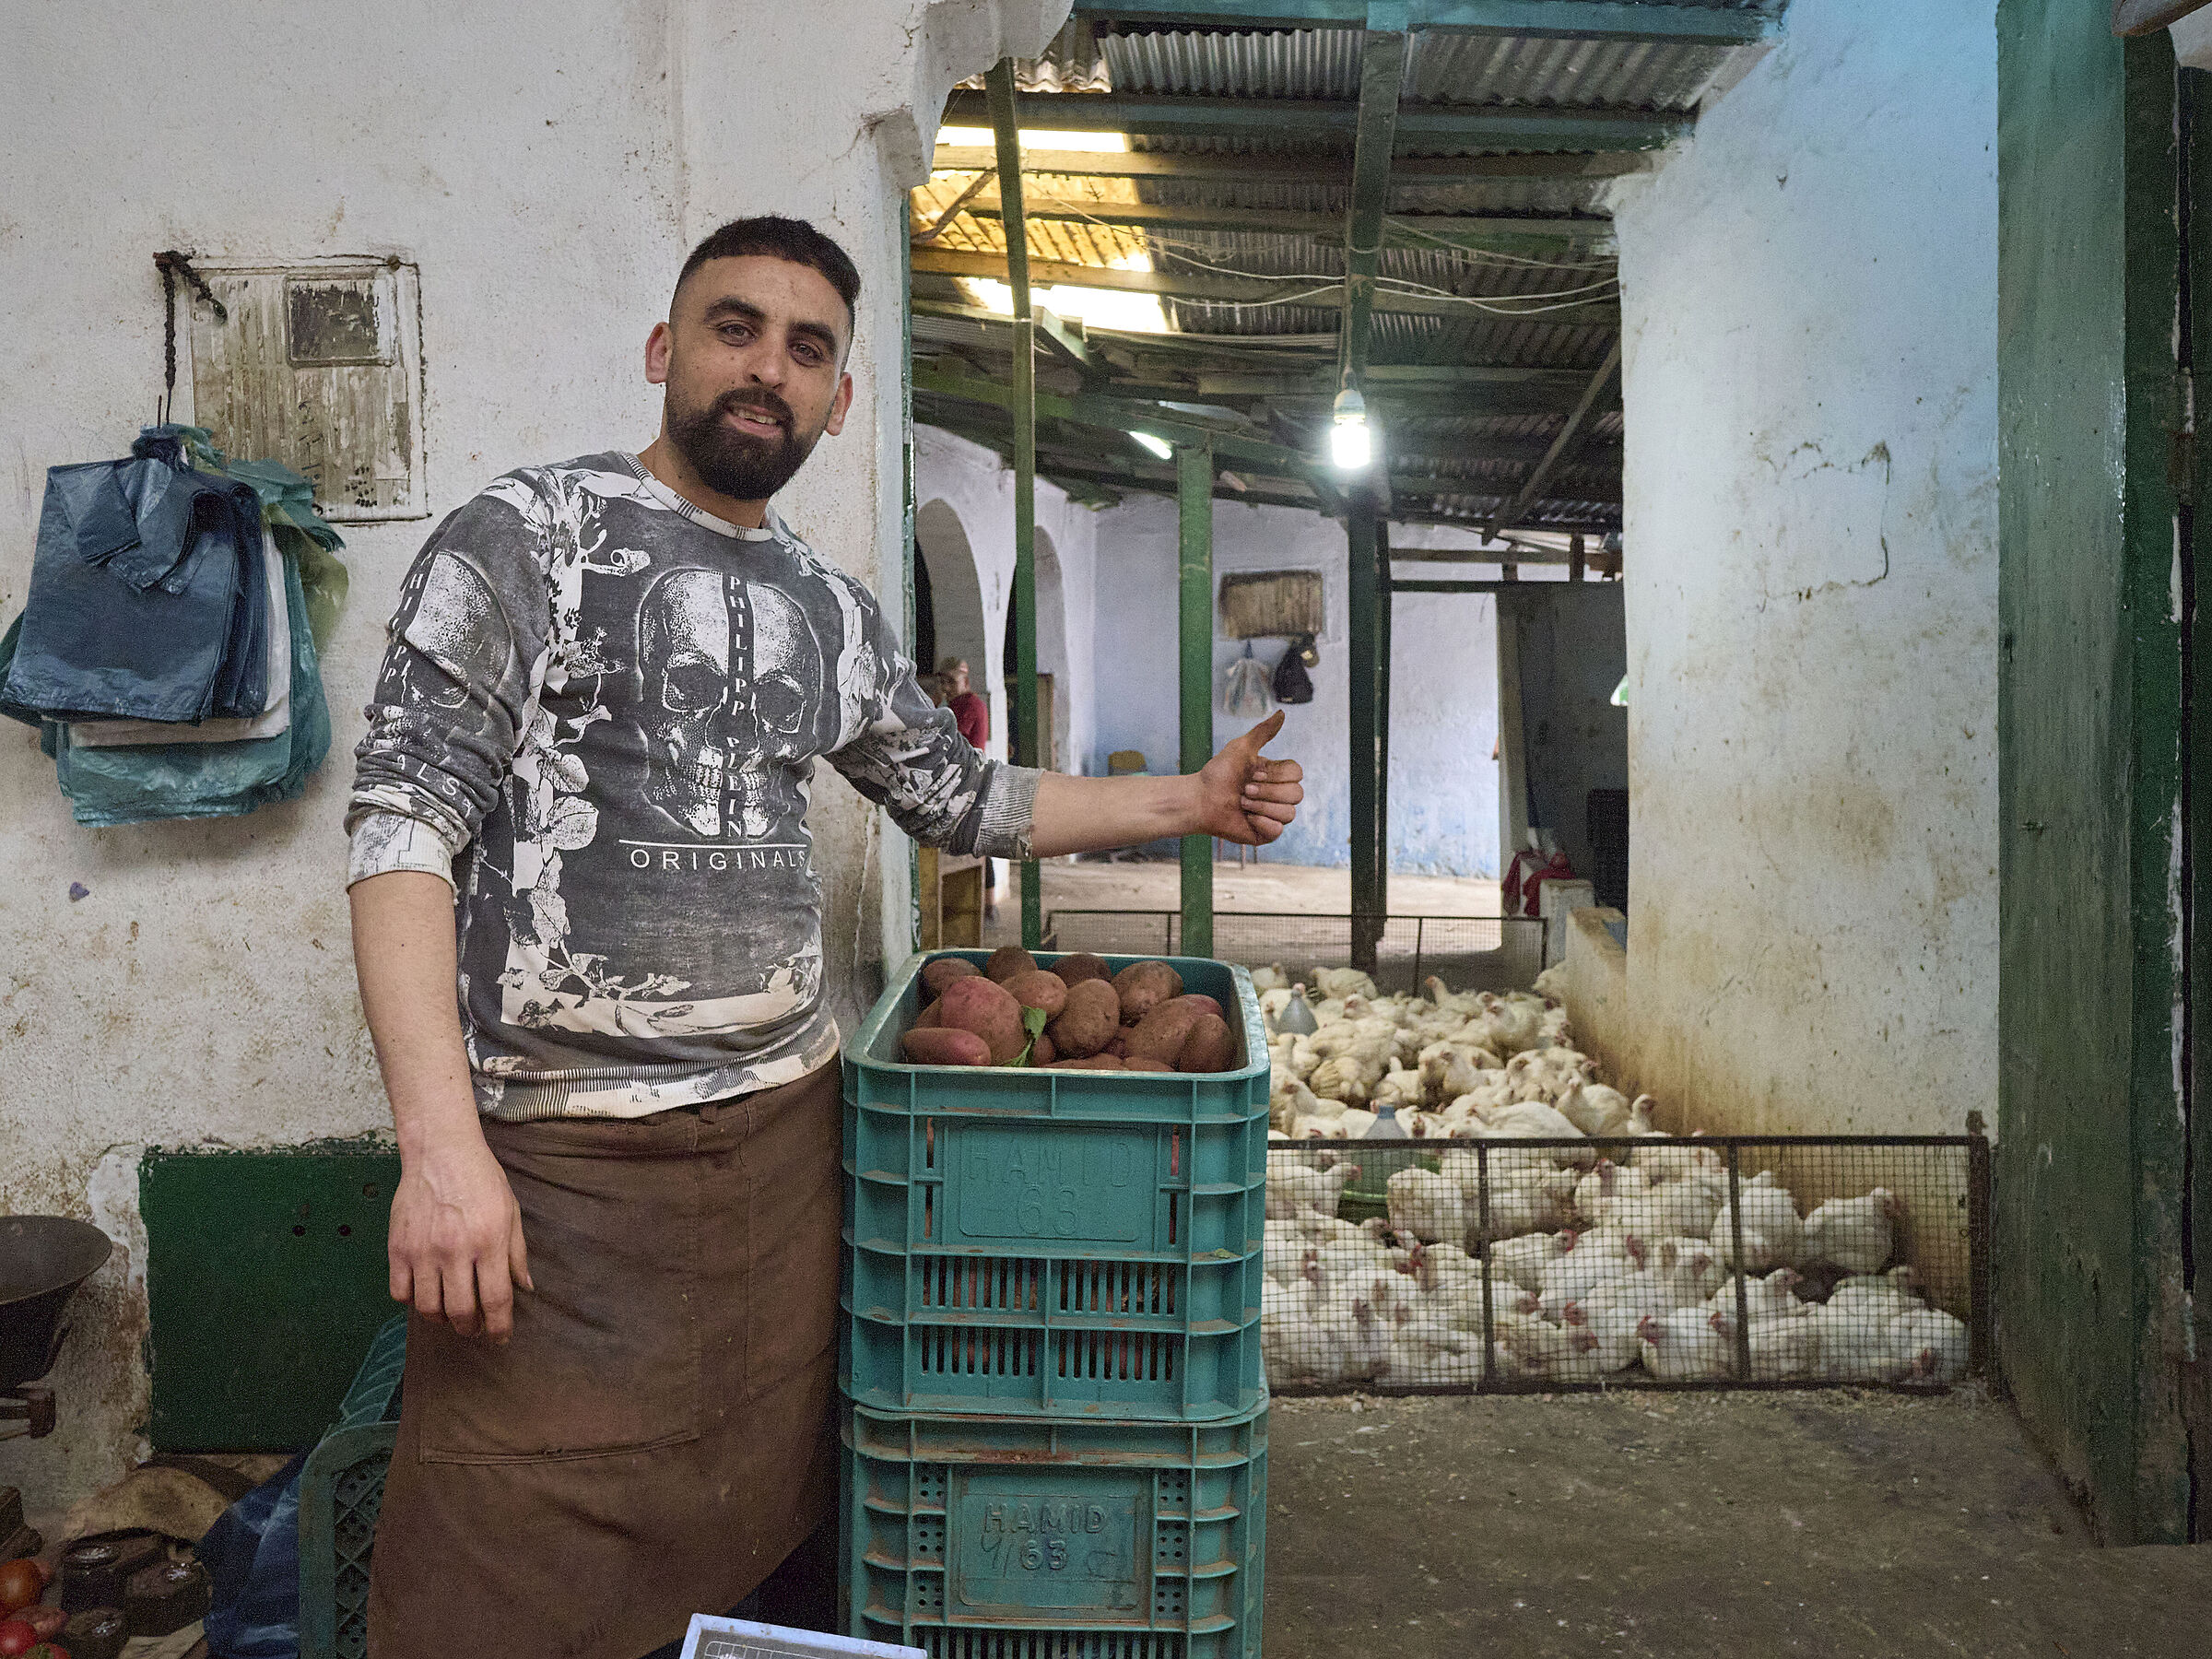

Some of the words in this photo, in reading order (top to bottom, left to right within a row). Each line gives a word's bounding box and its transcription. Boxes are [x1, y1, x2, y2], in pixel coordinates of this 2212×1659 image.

[729, 576, 747, 715] PHILIPP
[726, 736, 743, 838] PLEIN
[630, 849, 807, 871] ORIGINALS
[983, 1503, 1108, 1534] HAMID
